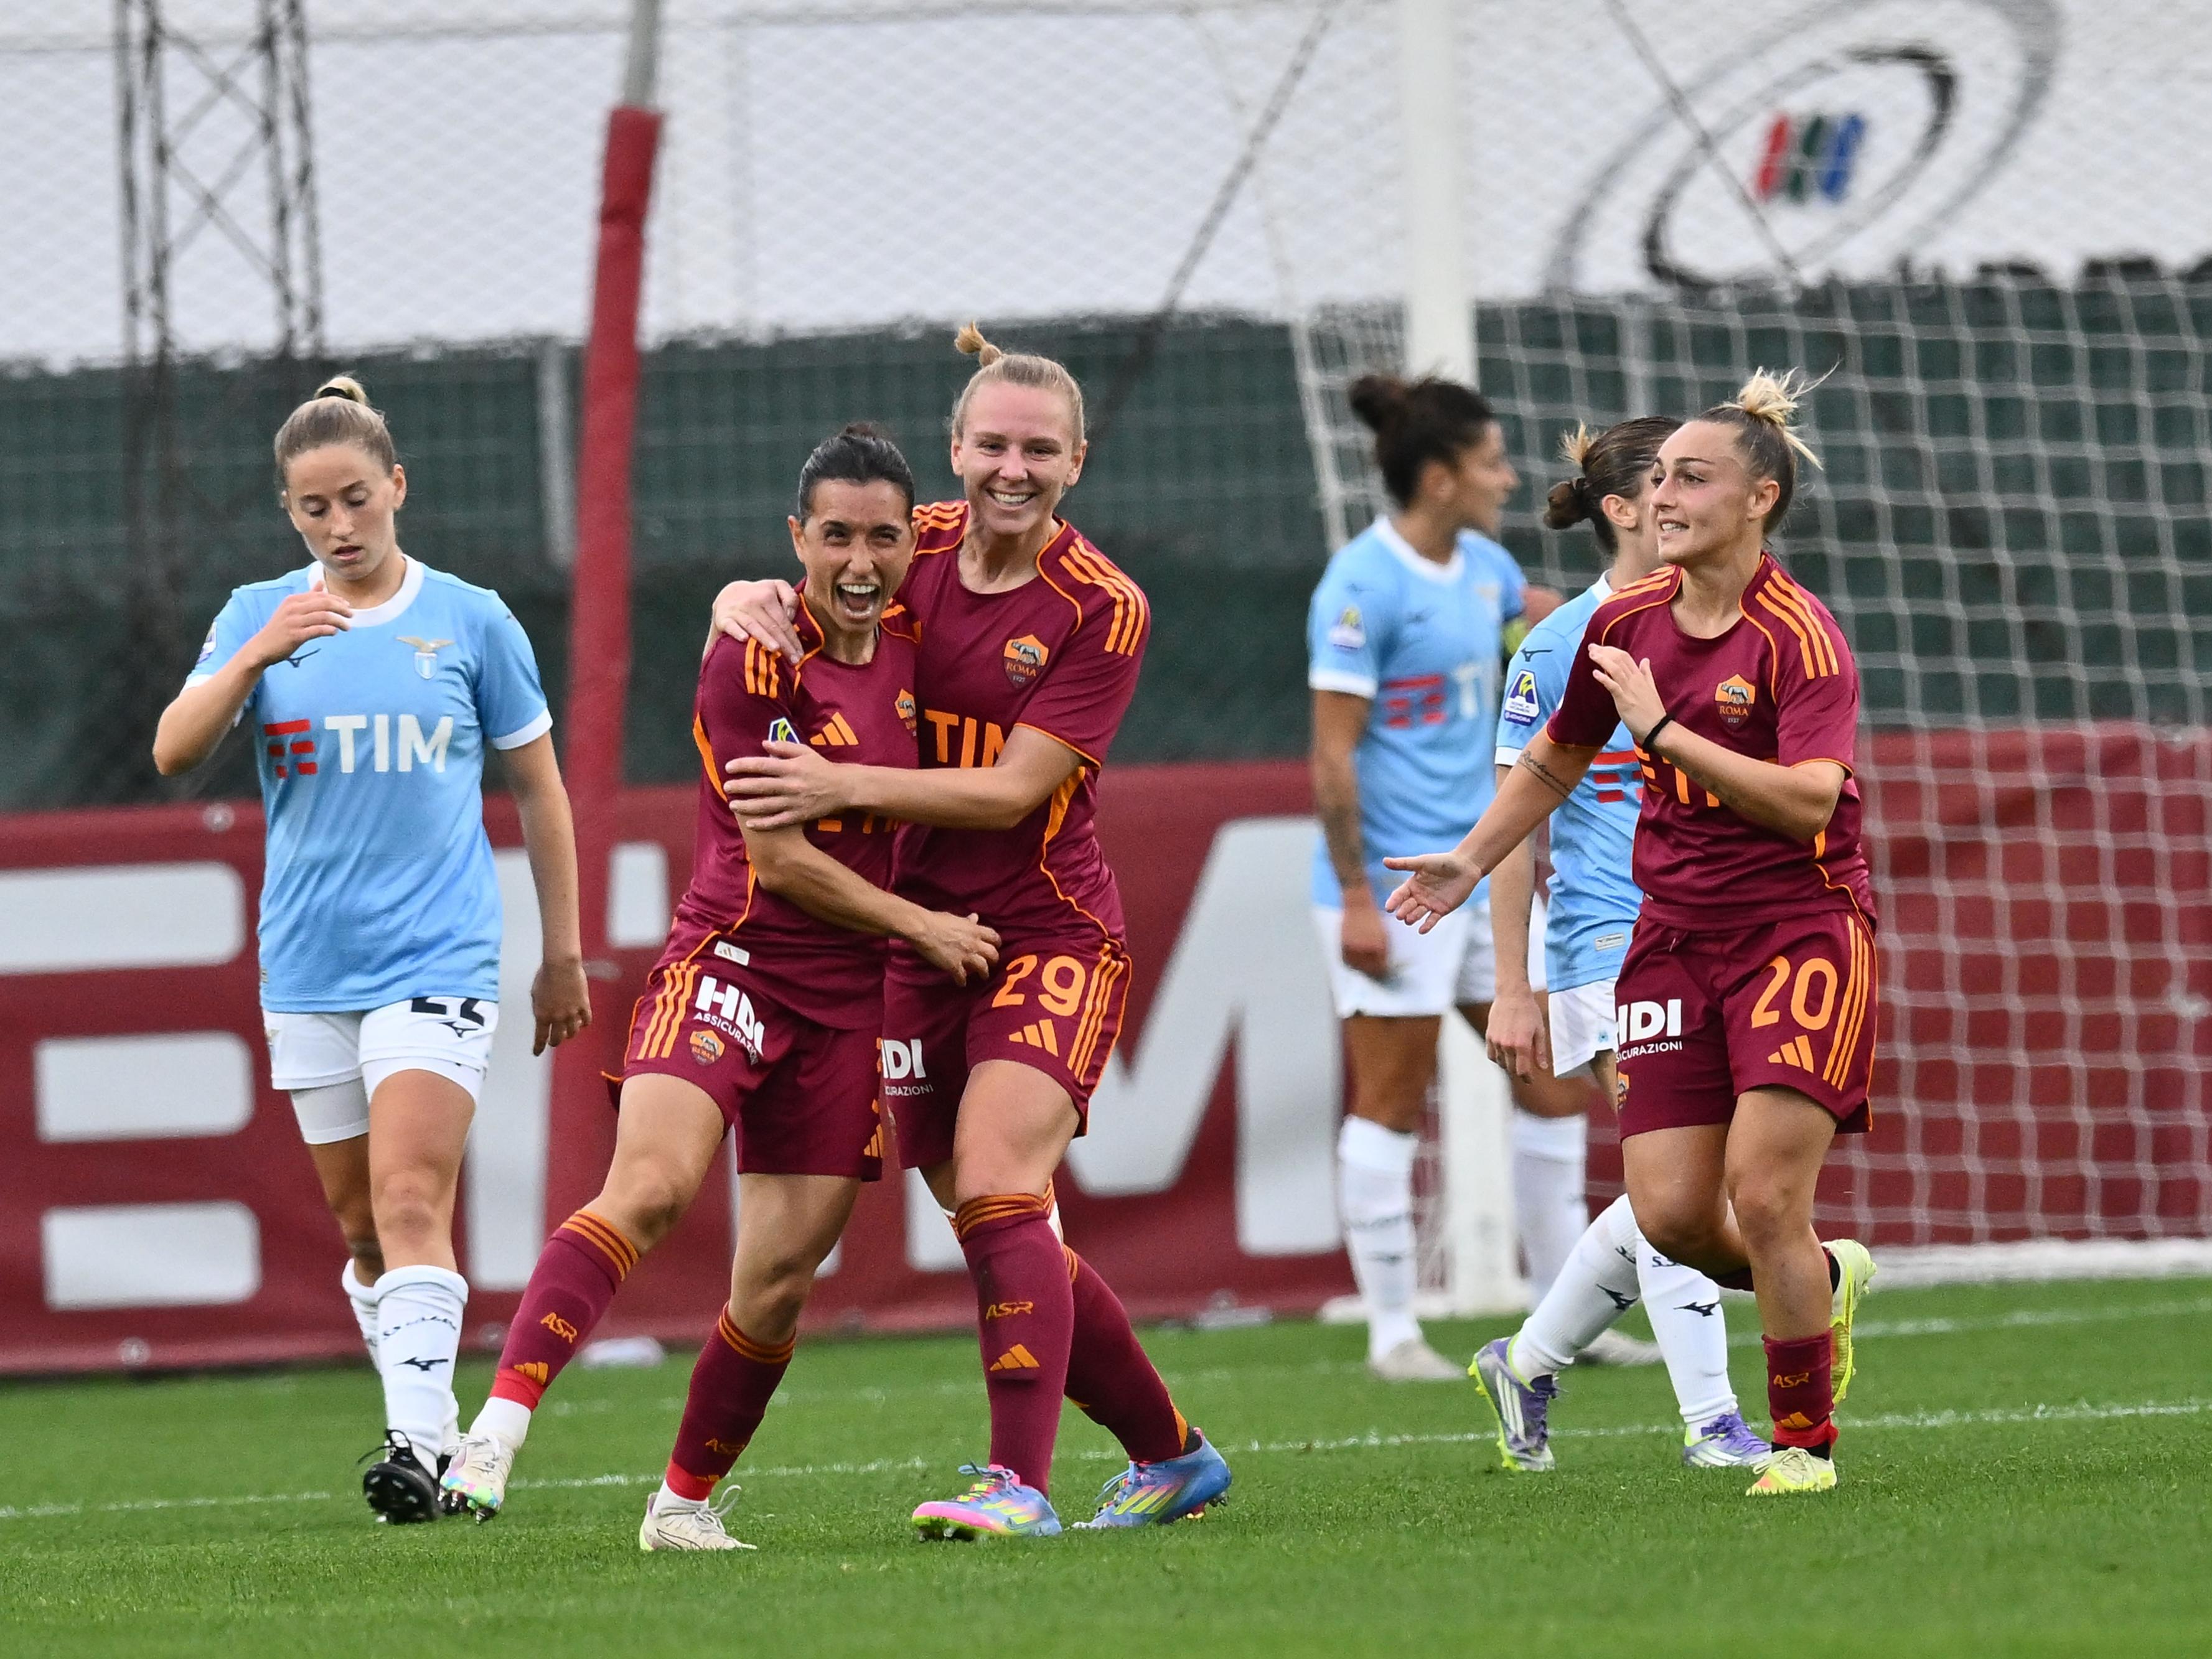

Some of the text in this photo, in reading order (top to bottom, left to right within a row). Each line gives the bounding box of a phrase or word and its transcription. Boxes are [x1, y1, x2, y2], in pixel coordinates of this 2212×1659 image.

[1006, 661, 1037, 677] ROMA
[1719, 705, 1749, 717] ROMA
[324, 714, 454, 773] TIM
[992, 954, 1086, 1017] 29
[1751, 955, 1838, 1030] 20
[695, 975, 765, 1057] HDI
[881, 1039, 927, 1080] DI
[1615, 1040, 1683, 1063] SICURAZIONI
[540, 1311, 579, 1344] ASR
[985, 1301, 1034, 1321] ASR
